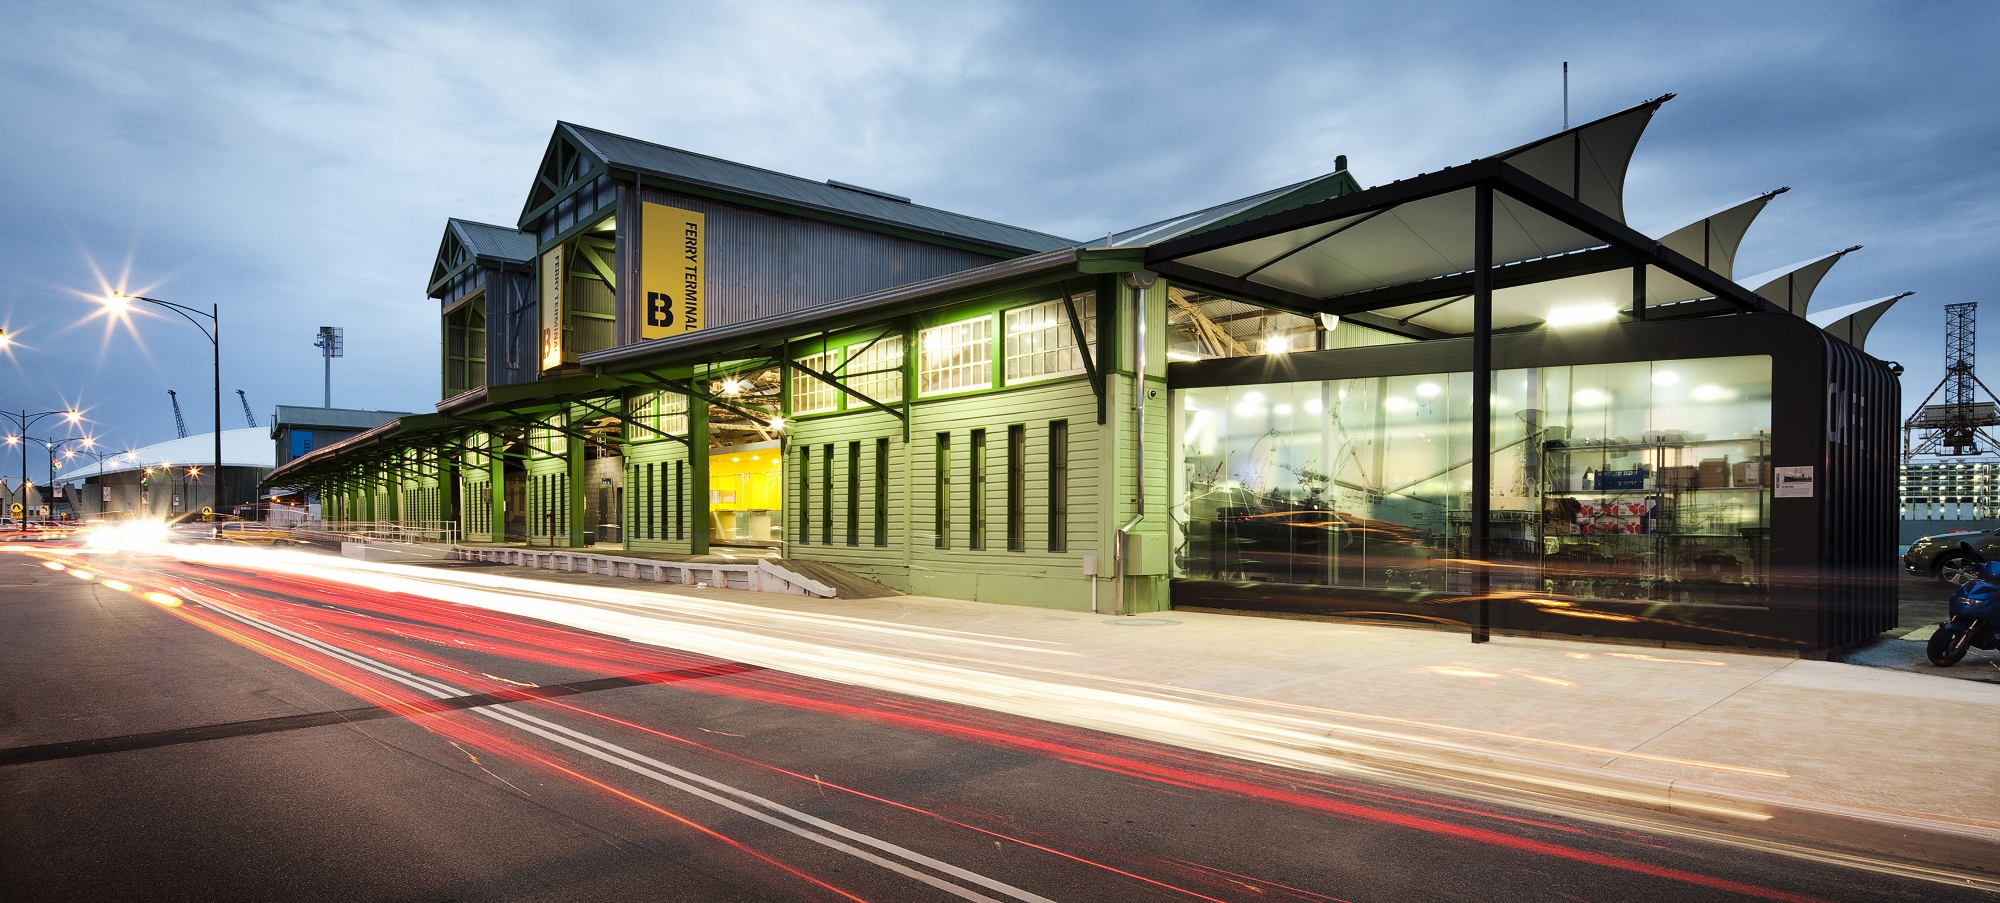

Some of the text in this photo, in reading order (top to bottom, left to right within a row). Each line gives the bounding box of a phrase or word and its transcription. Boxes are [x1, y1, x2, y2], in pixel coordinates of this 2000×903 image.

[684, 221, 698, 331] FERRY TERMINAL
[646, 291, 675, 328] B
[543, 328, 551, 360] B
